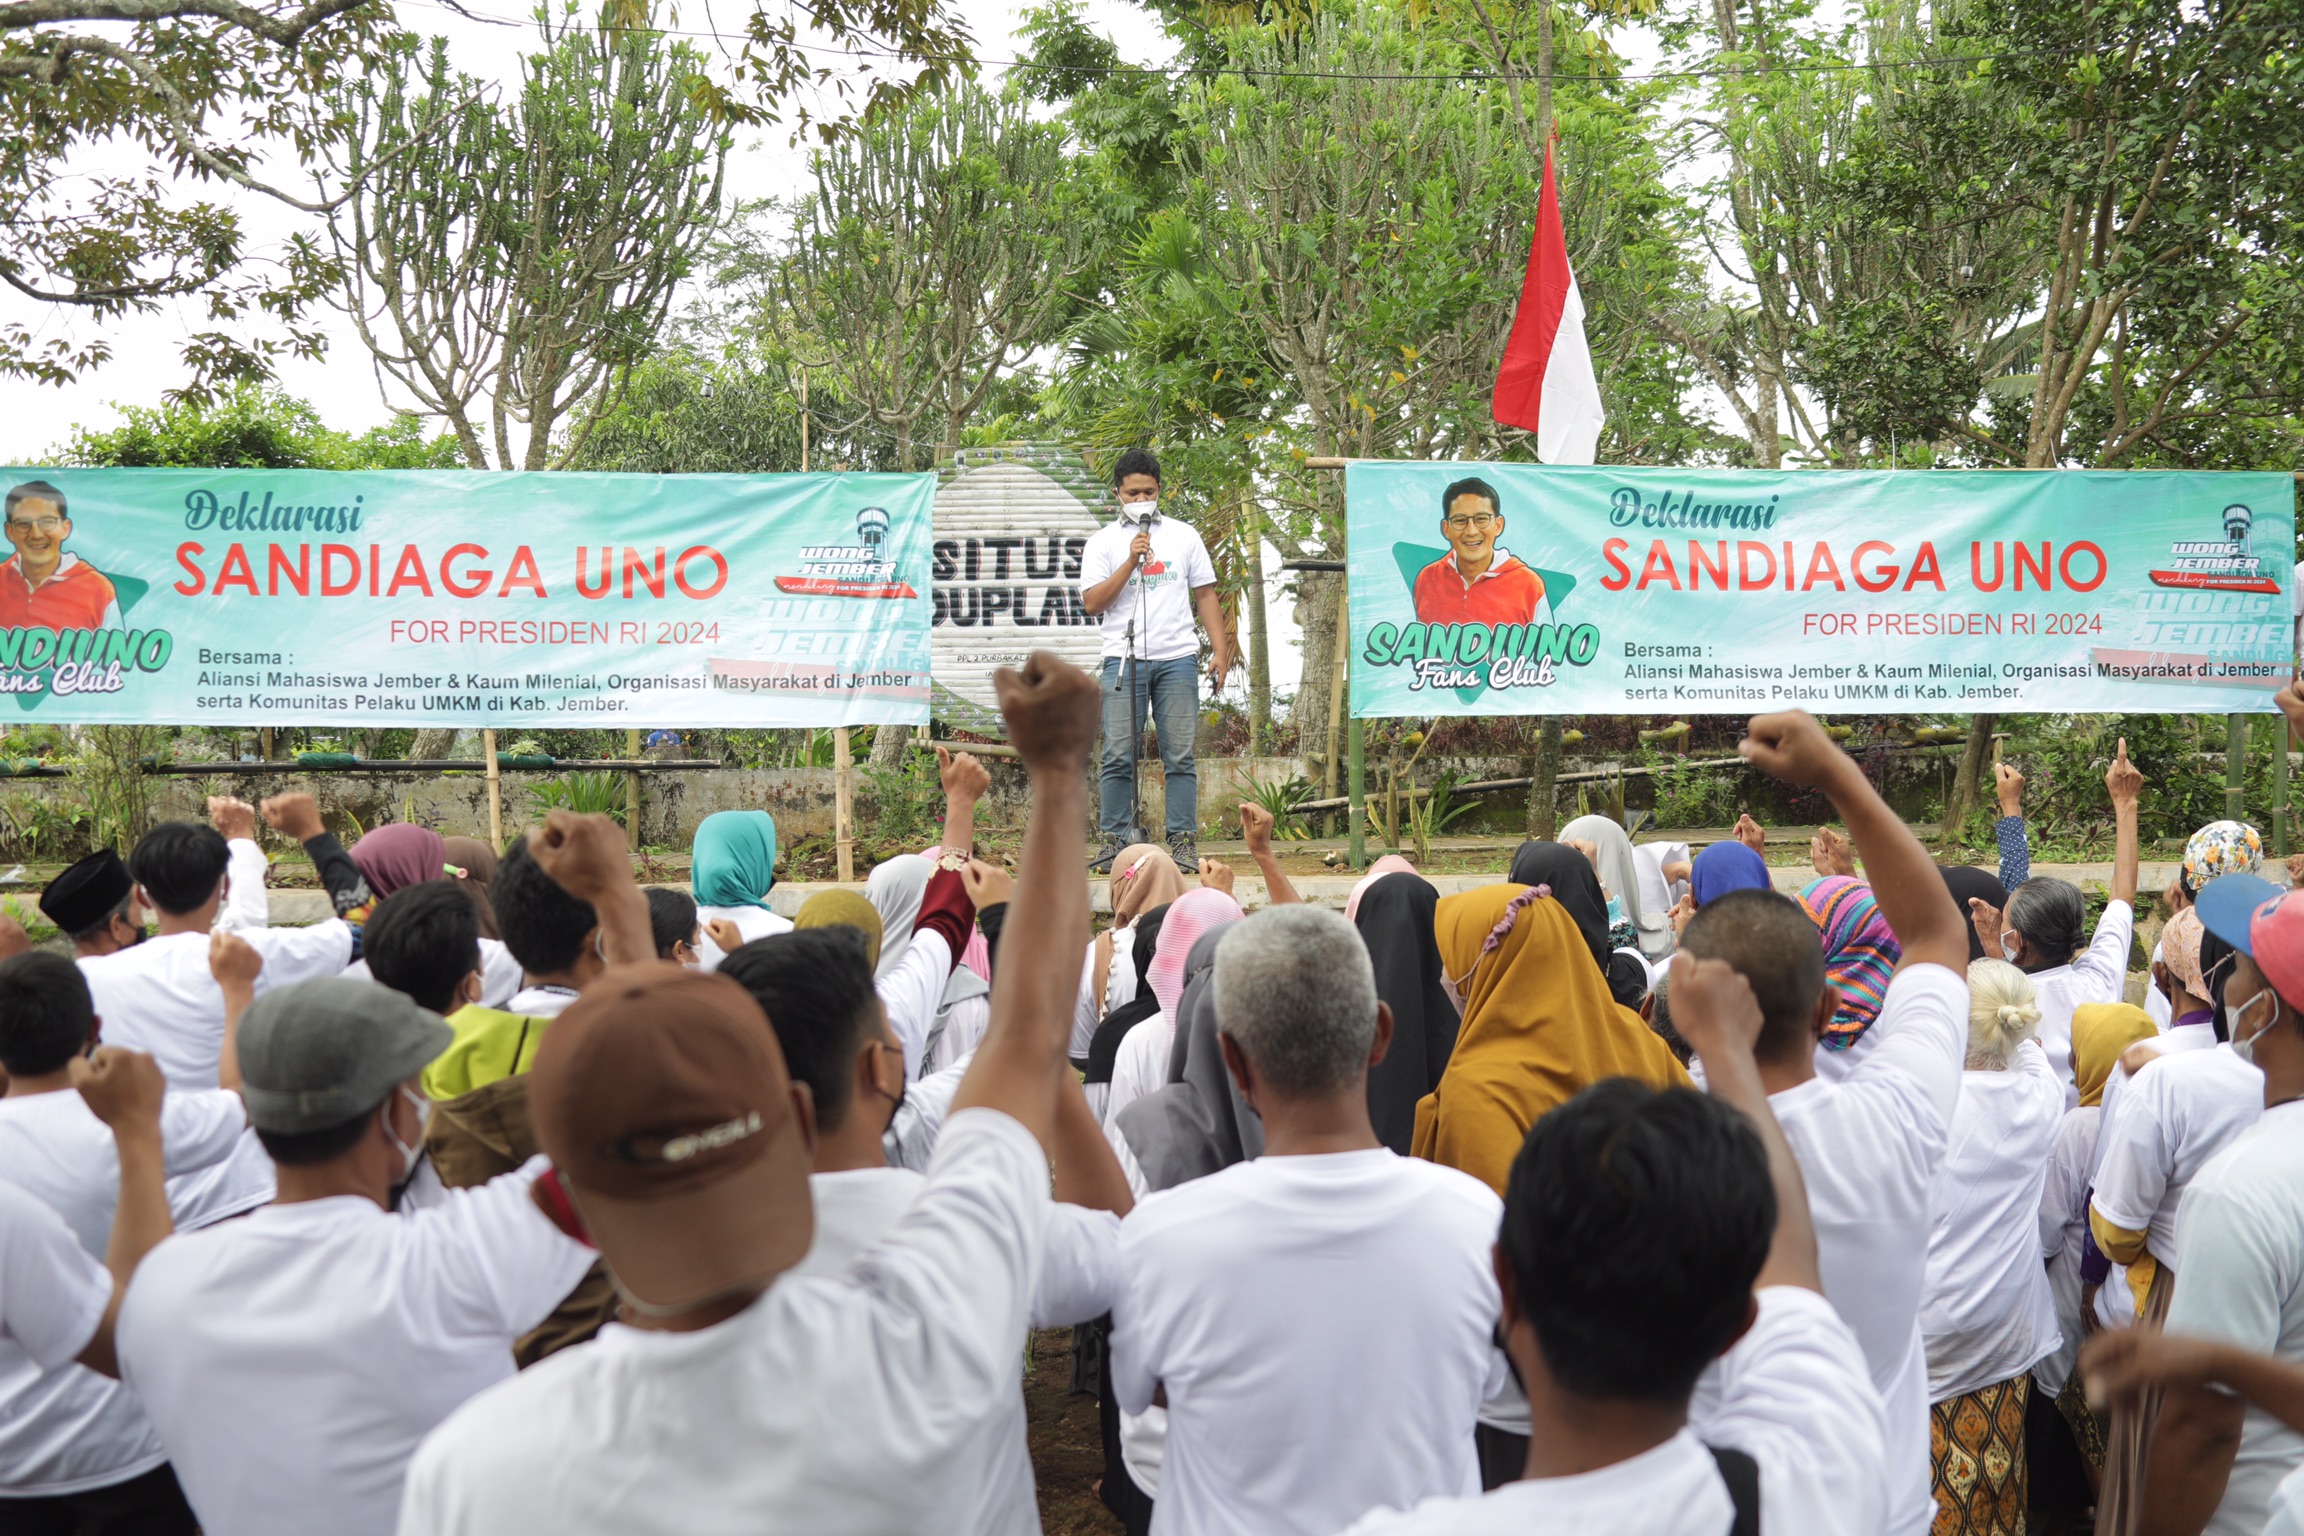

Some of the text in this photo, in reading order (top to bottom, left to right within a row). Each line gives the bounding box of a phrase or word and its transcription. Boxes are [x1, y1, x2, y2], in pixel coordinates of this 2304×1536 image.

[185, 489, 364, 534] Deklarasi
[1609, 487, 1780, 531] Deklarasi
[799, 546, 874, 559] WONG
[2170, 542, 2240, 555] WONG
[173, 541, 729, 600] SANDIAGA UNO
[798, 562, 897, 575] JEMBER
[1599, 537, 2108, 593] SANDIAGA UNO
[2171, 557, 2261, 569] JEMBER
[1128, 571, 1179, 586] SNDIUNO
[392, 619, 720, 645] FOR PRESIDEN RI 2024
[1803, 613, 2103, 636] FOR PRESIDEN RI 2024
[0, 627, 173, 673] NDIUNO
[753, 628, 931, 655] JEMBE
[1363, 622, 1601, 667] SANDIUNO
[1624, 642, 1702, 658] Bersama
[199, 648, 282, 665] Bersama
[0, 659, 125, 697] ans Club
[197, 671, 261, 687] Aliansi
[267, 672, 368, 688] Mahasiswa
[373, 673, 442, 689] Jember
[447, 674, 461, 689] &
[467, 674, 519, 689] Kaum
[526, 674, 602, 692] Milenial,
[607, 674, 707, 692] Organisasi
[713, 674, 819, 692] Masyarakat
[823, 673, 841, 689] di
[846, 671, 912, 689] Jember
[1408, 654, 1556, 692] Fans Club
[1624, 663, 1683, 679] Aliansi
[1689, 664, 1783, 679] Mahasiswa
[1788, 664, 1852, 679] Jember
[1856, 664, 1870, 679] &
[1875, 663, 1923, 679] Kaum
[1928, 663, 1997, 682] Milenial,
[2003, 663, 2092, 682] Organisasi
[2097, 663, 2193, 681] Masyarakat
[2197, 662, 2213, 677] di
[2218, 662, 2277, 677] Jember
[197, 694, 629, 711] serta Komunitas Pelaku UMKM di Kab. Jember.
[1625, 684, 2023, 699] serta Komunitas Pelaku UMKM di Kab. Jember.
